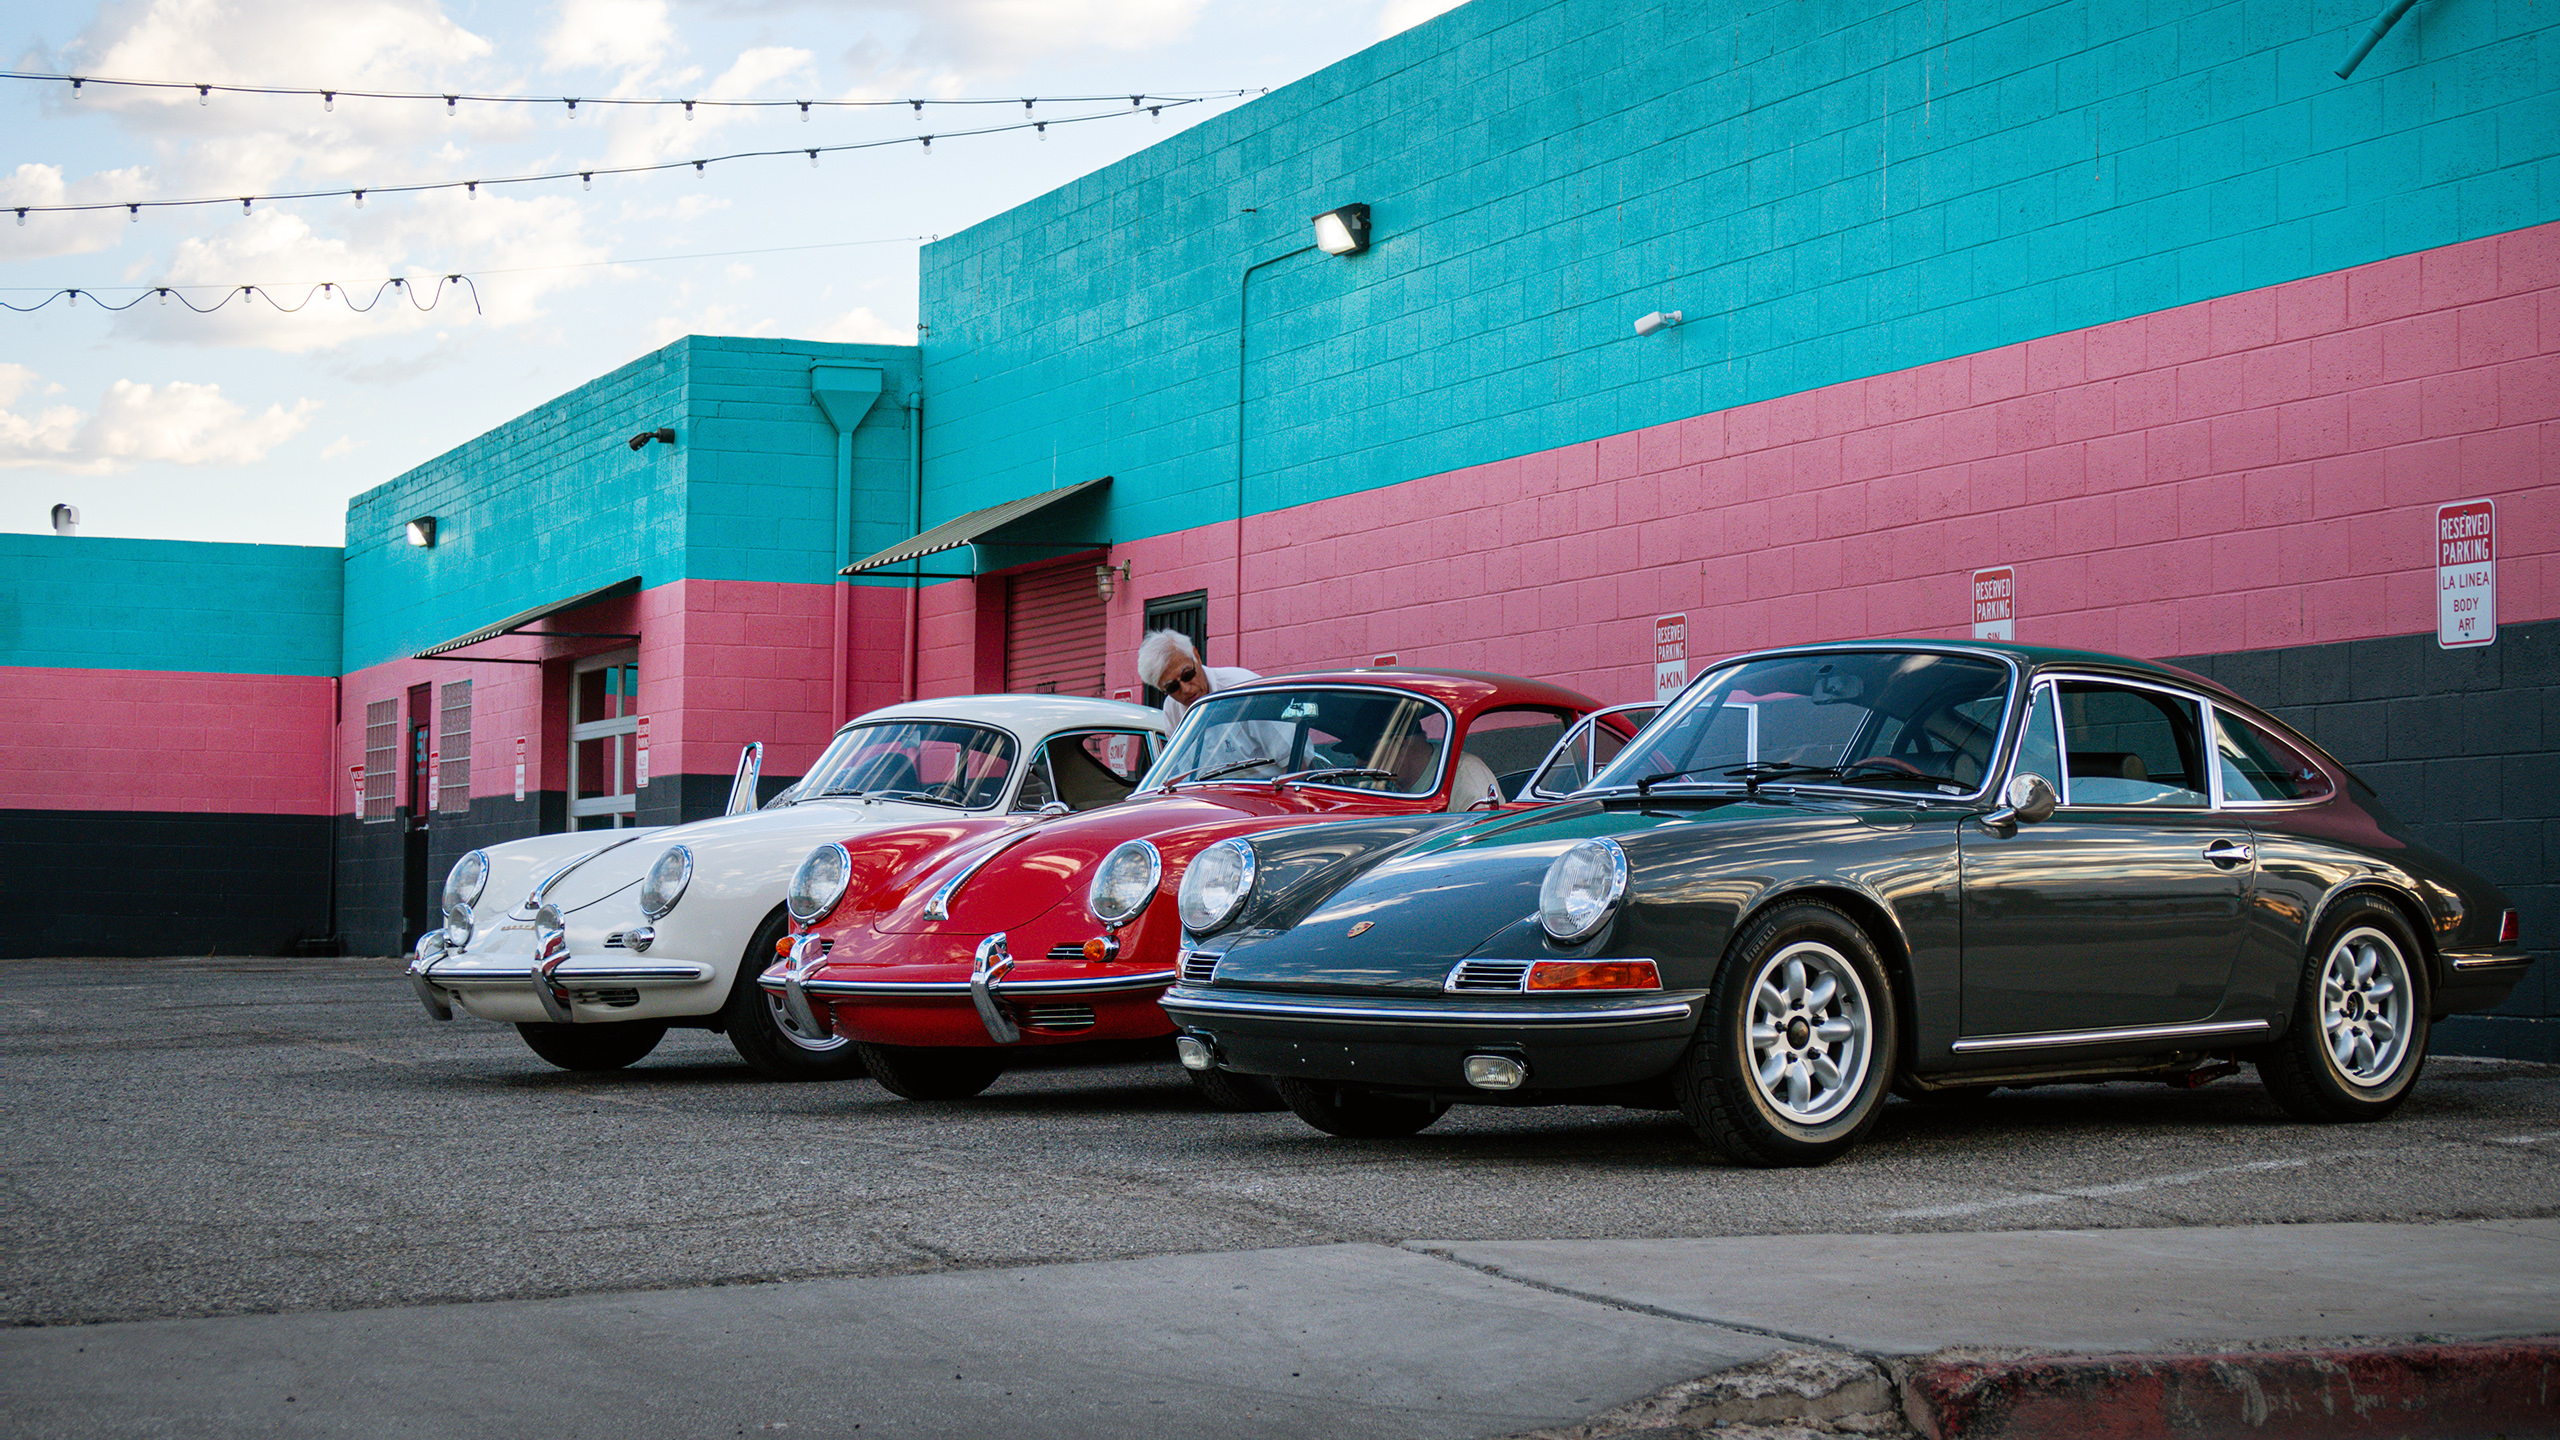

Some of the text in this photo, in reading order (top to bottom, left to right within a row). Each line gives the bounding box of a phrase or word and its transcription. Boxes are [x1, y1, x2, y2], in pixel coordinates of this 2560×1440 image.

[2441, 513, 2490, 541] RESERVED
[2442, 538, 2489, 564] PARKING
[1975, 578, 2011, 601] RESERVED
[2442, 571, 2490, 590] LA LINEA
[1976, 599, 2010, 621] PARKING
[2453, 597, 2479, 612] BODY
[1657, 624, 1685, 644] RESERVED
[2458, 617, 2476, 631] ART
[1658, 642, 1684, 662] PARKING
[1659, 670, 1683, 690] AKIN
[1110, 743, 1126, 759] SONIC
[1741, 922, 1777, 963] PIRELLI
